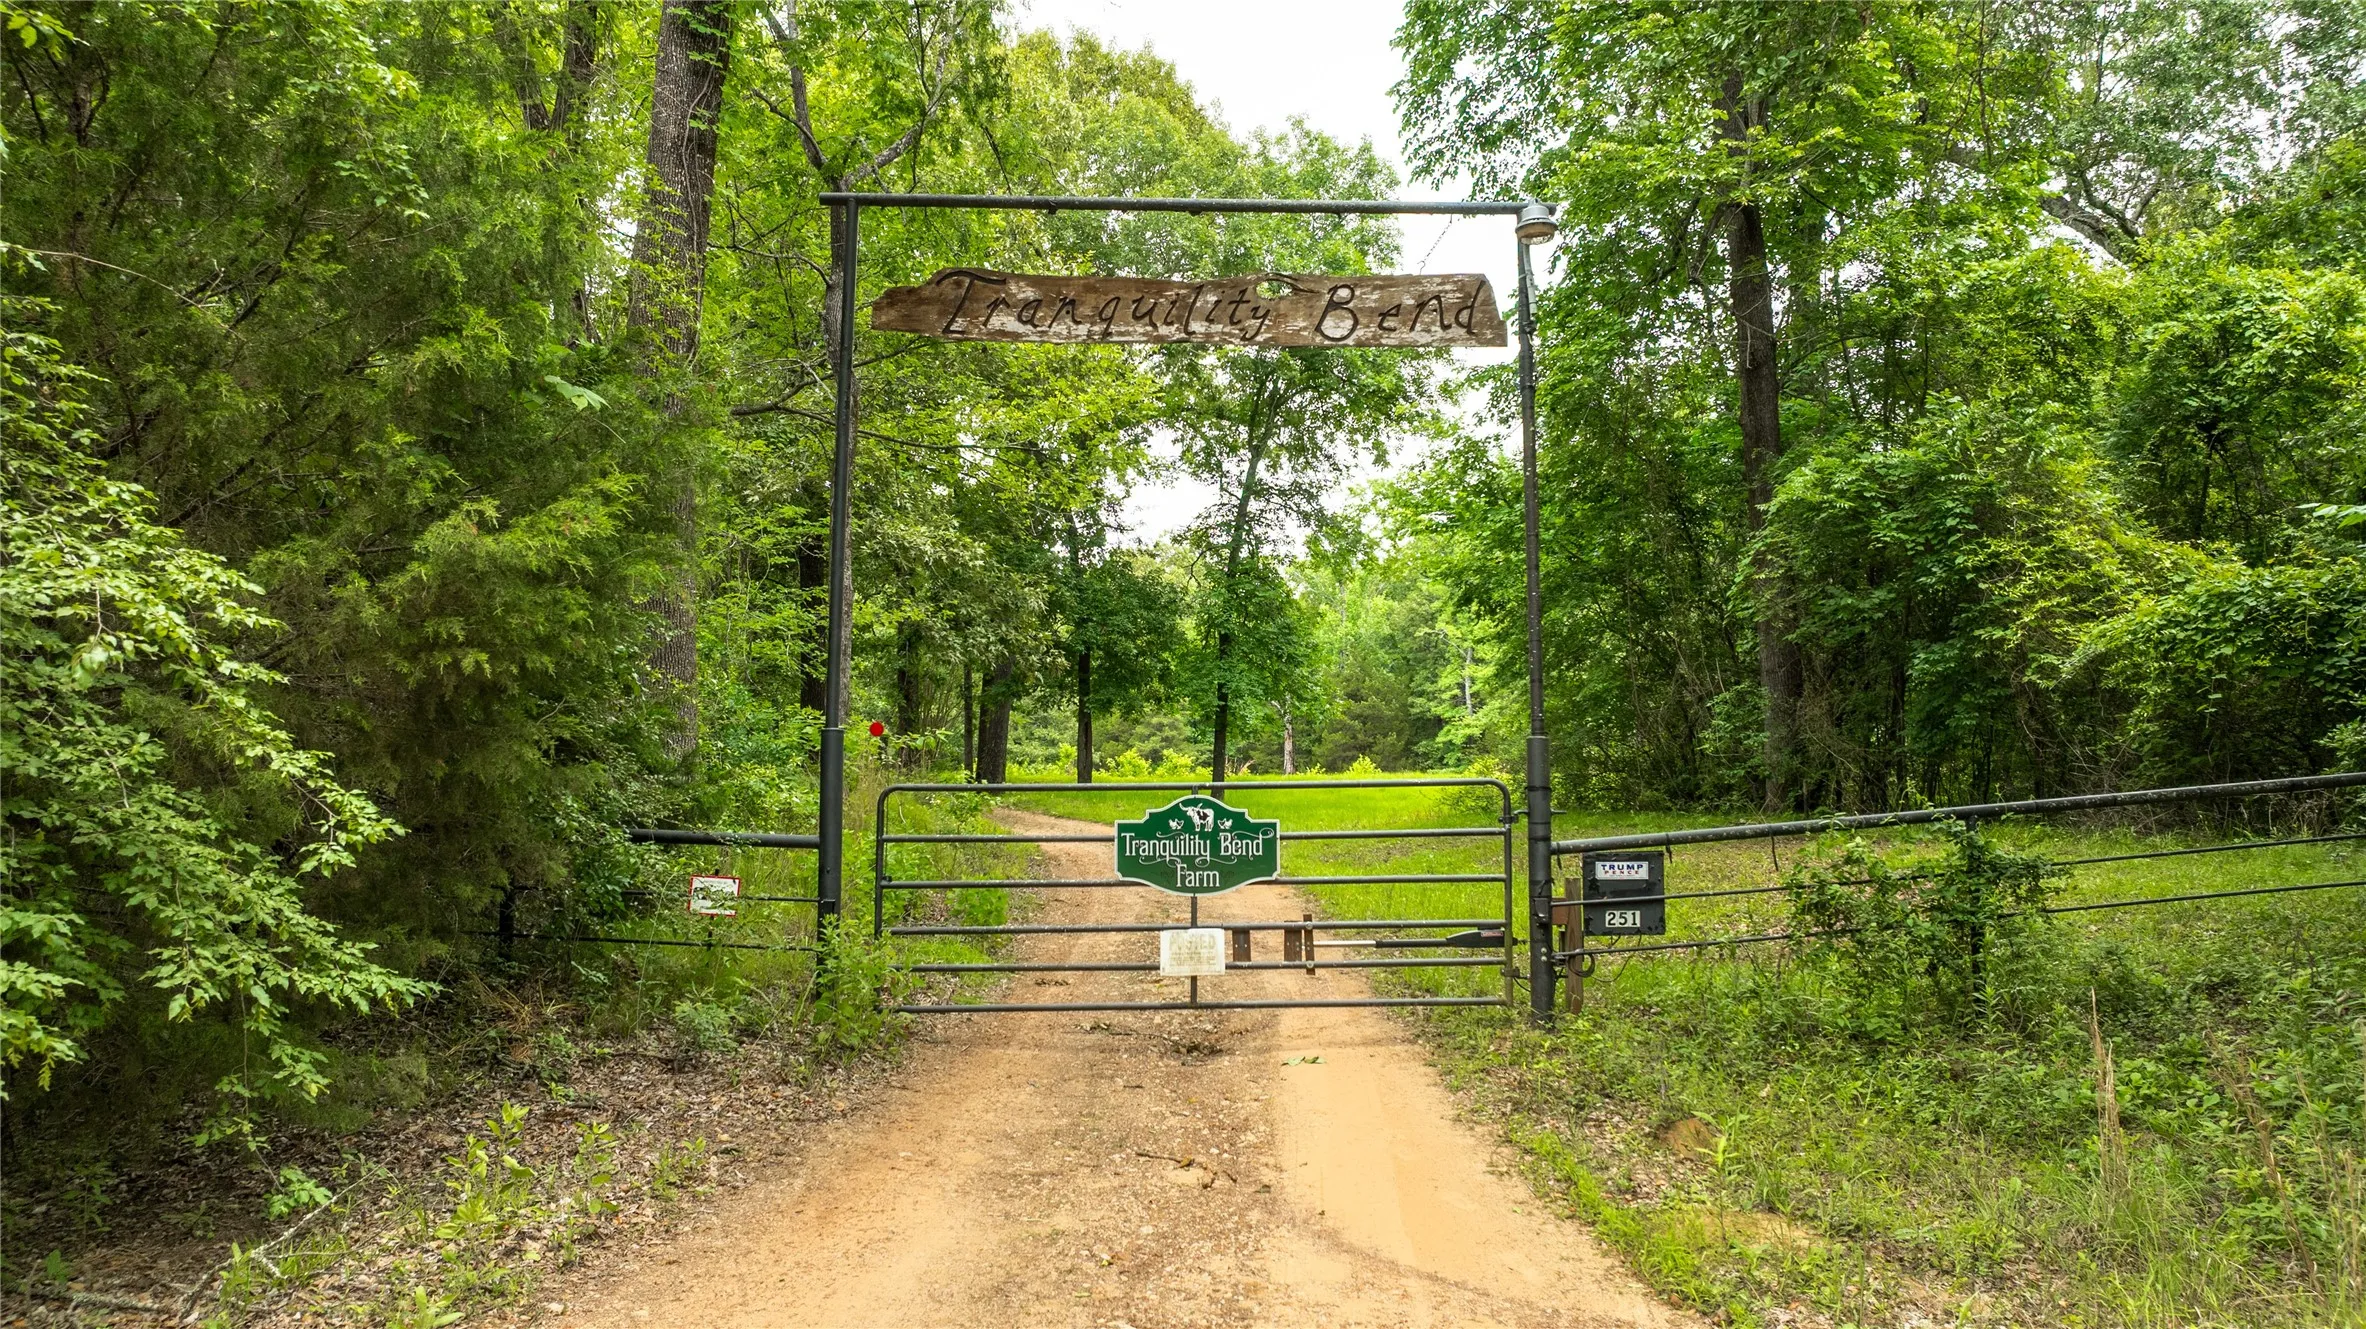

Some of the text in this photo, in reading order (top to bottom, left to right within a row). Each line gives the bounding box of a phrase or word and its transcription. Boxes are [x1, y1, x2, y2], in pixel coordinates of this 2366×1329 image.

[936, 270, 1487, 342] Tranquility Bend
[1121, 831, 1268, 866] Tranquility Bend
[1176, 863, 1220, 887] Farm
[1600, 863, 1644, 871] TRUMP
[1606, 911, 1638, 926] 251
